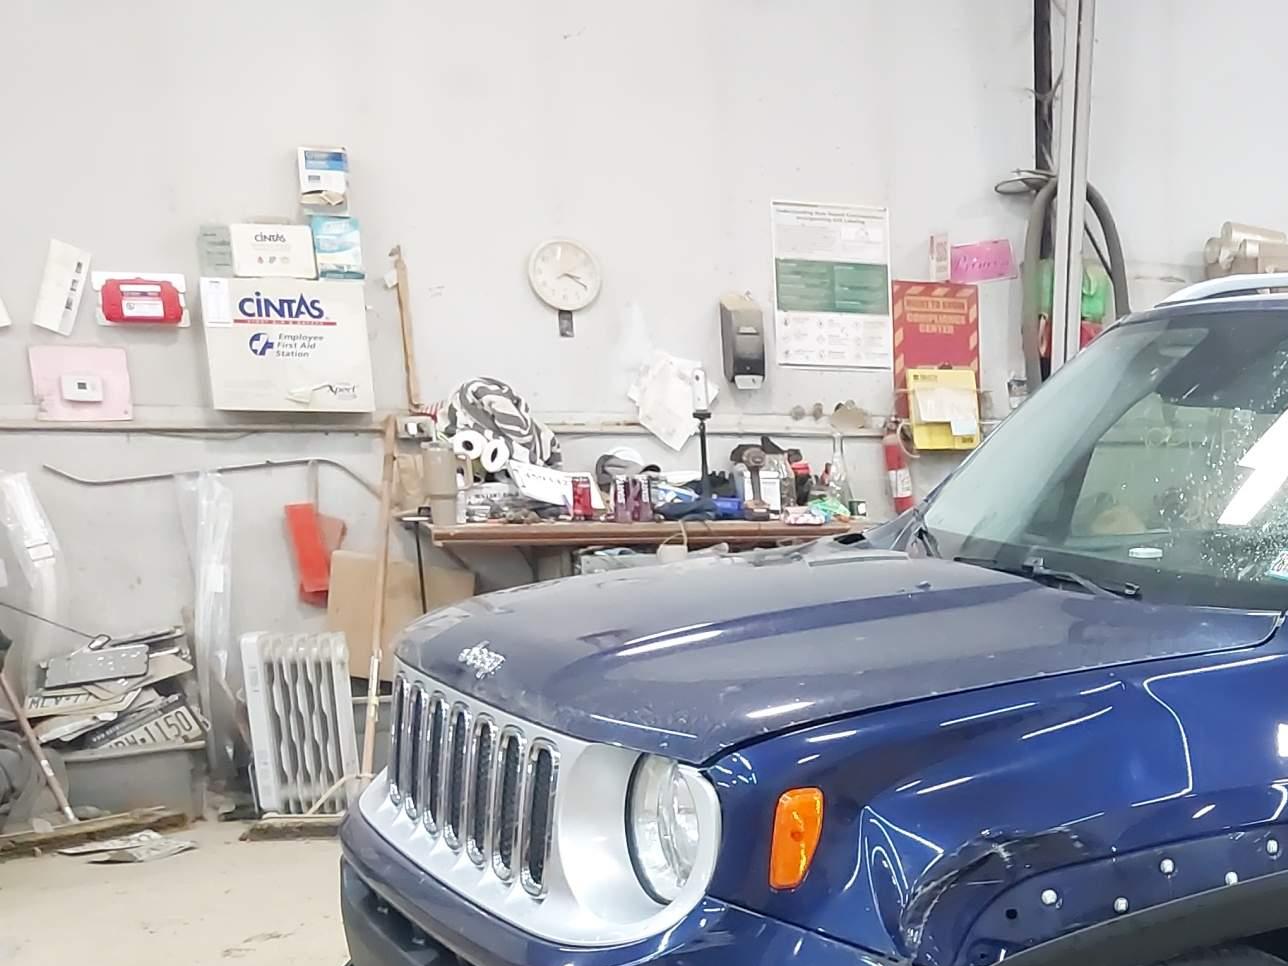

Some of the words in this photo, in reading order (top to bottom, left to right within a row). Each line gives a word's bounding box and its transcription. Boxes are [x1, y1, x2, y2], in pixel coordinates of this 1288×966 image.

[238, 291, 324, 319] CINTAS
[278, 333, 324, 342] Employee
[275, 350, 310, 358] Station
